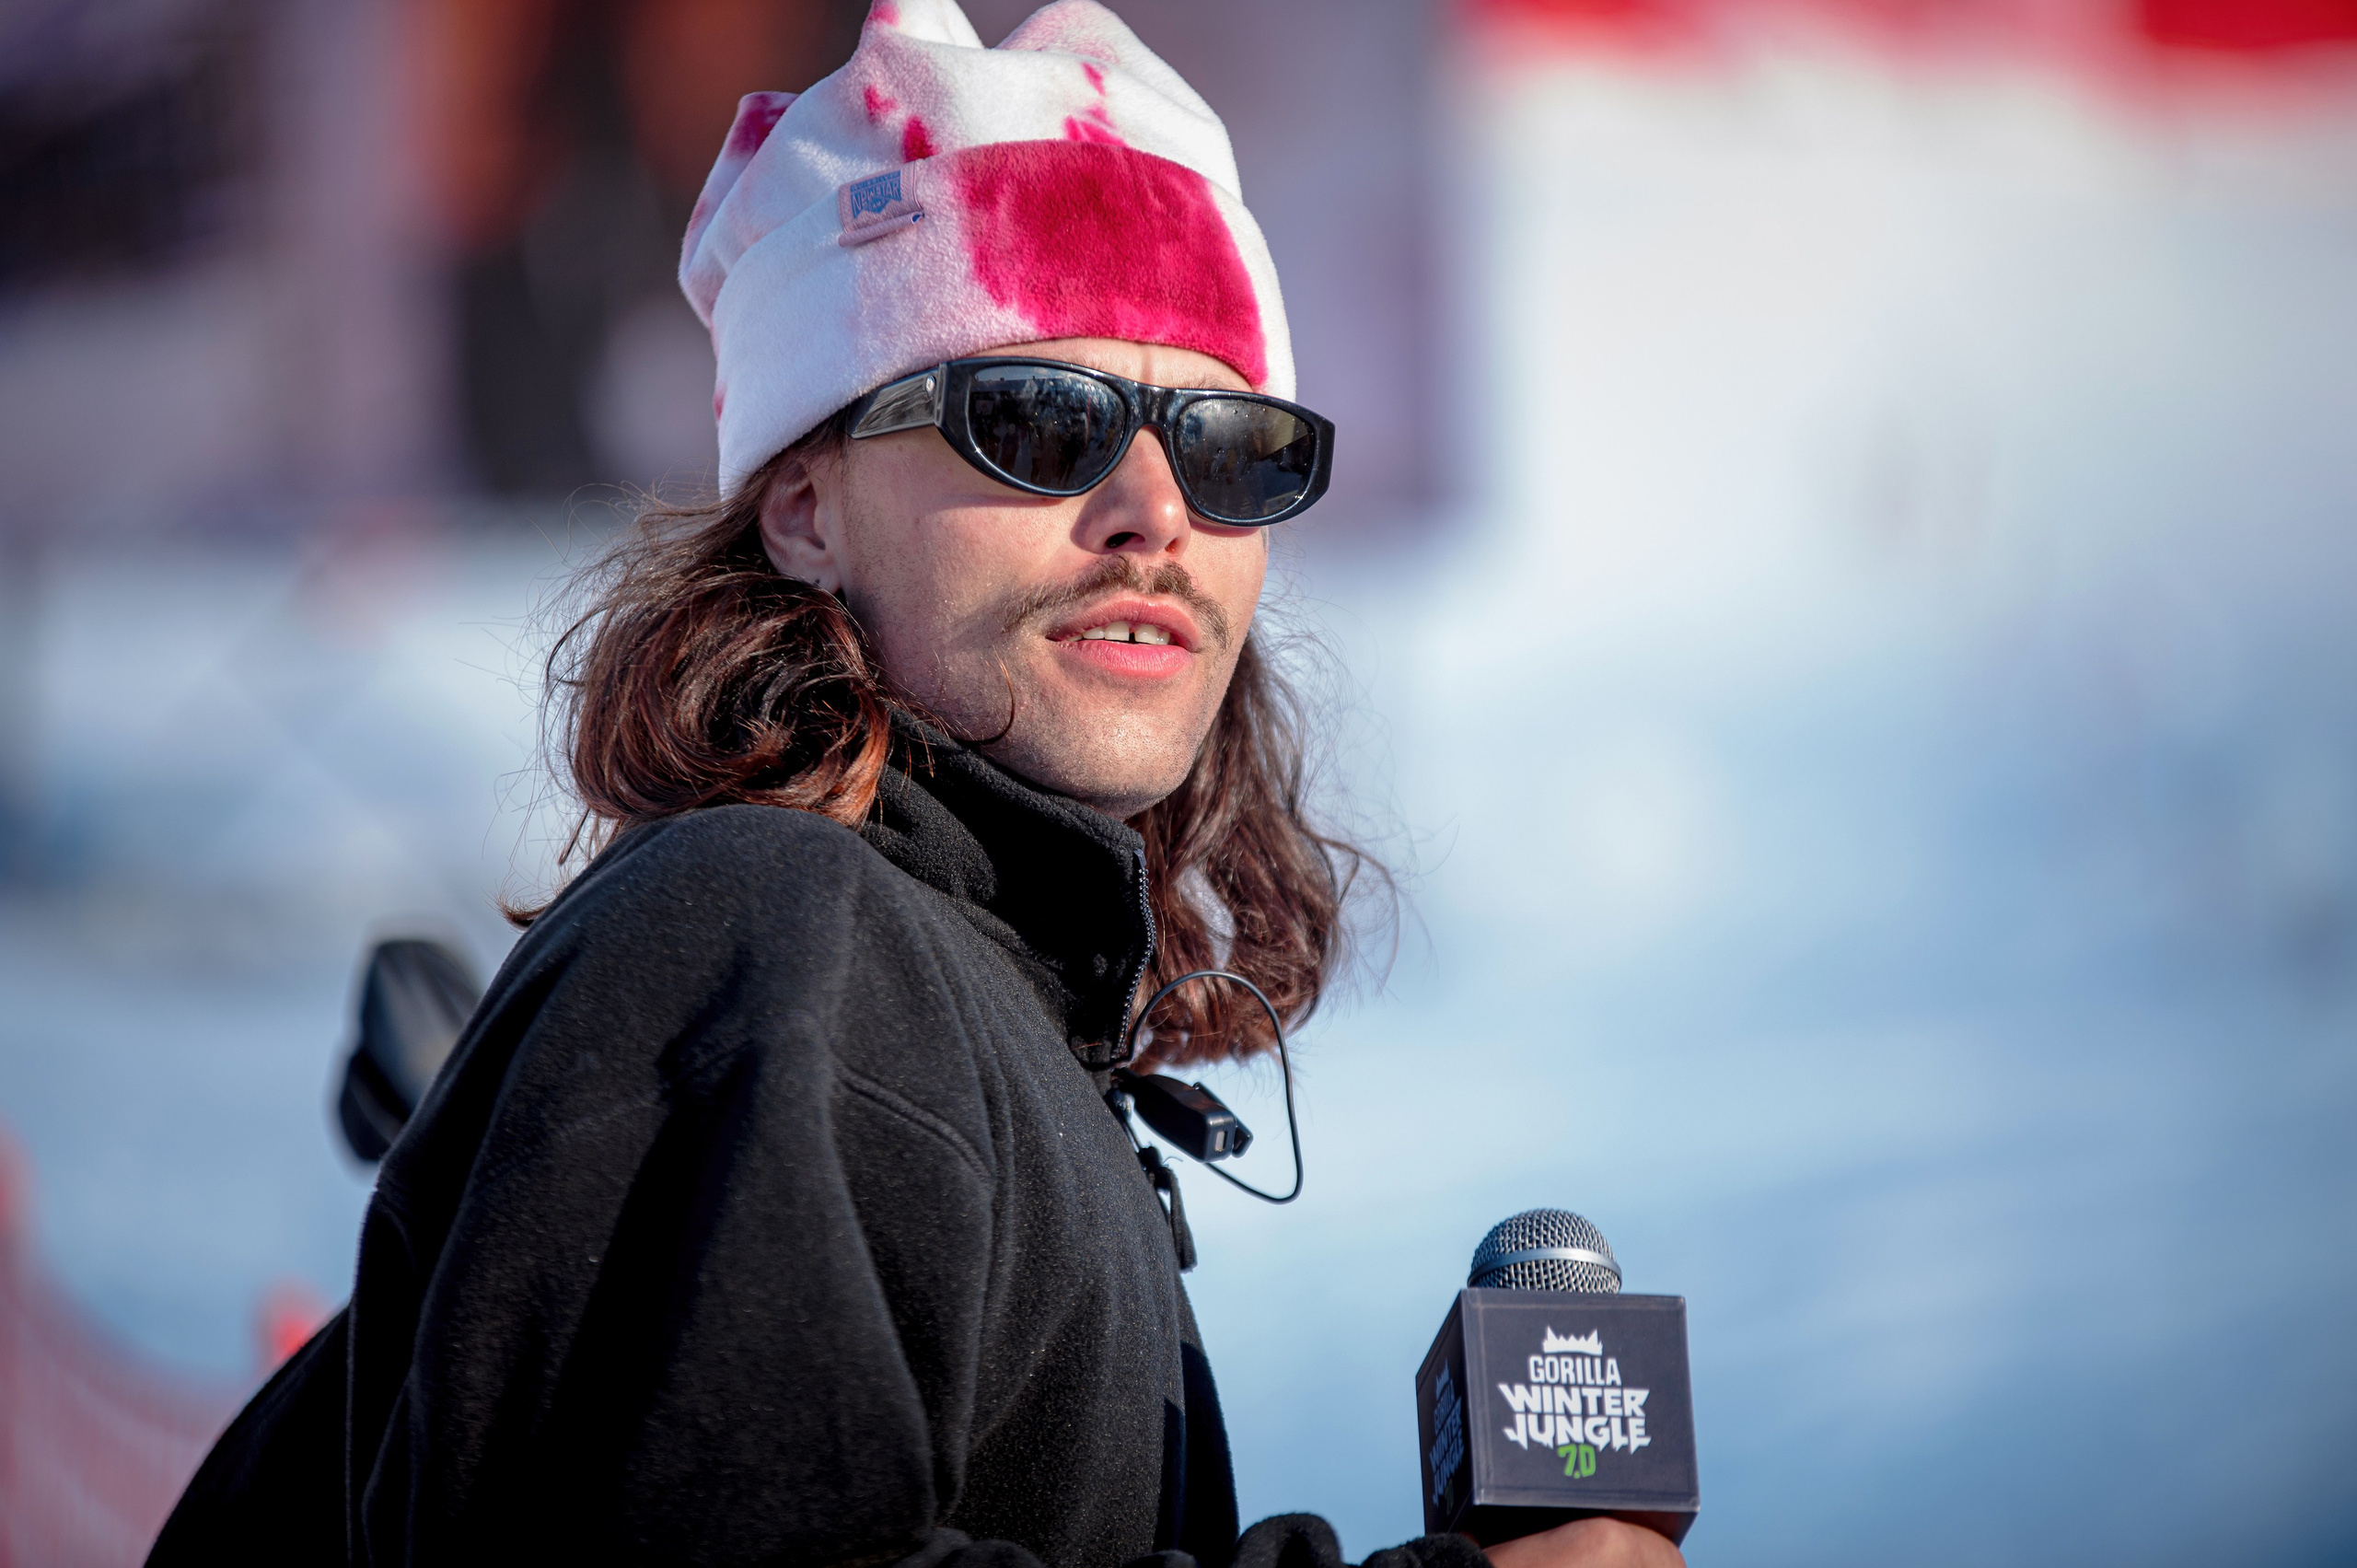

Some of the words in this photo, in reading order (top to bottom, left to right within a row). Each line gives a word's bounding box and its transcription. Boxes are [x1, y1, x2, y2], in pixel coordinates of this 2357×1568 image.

[1529, 1355, 1622, 1386] GORILLA
[1498, 1383, 1650, 1417] WINTER
[1429, 1396, 1462, 1473] WINTER
[1503, 1413, 1652, 1455] JUNGLE
[1433, 1427, 1464, 1507] JUNGLE
